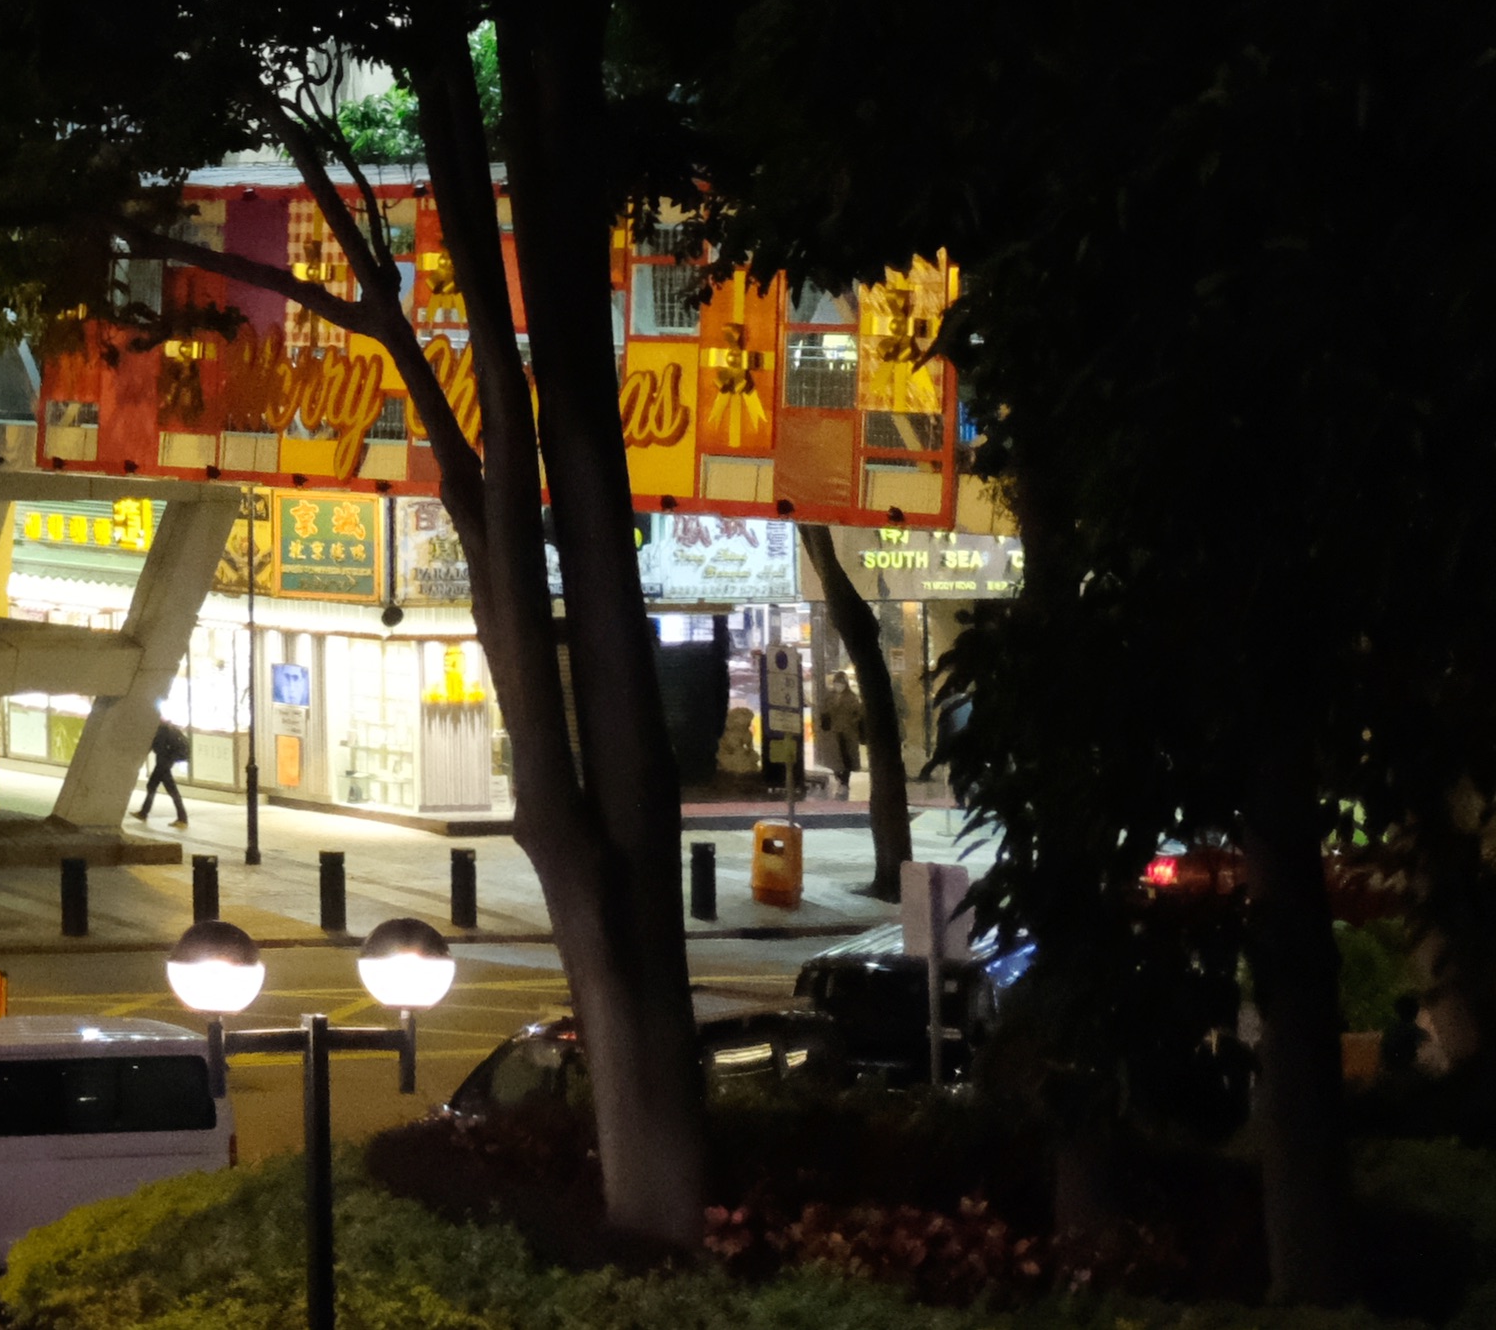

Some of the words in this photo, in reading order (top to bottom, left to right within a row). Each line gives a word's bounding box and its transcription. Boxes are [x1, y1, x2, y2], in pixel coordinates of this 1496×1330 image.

[864, 549, 928, 568] SOUTH
[945, 549, 984, 568] SEA
[1010, 550, 1025, 568] C
[955, 580, 977, 590] ROAD
